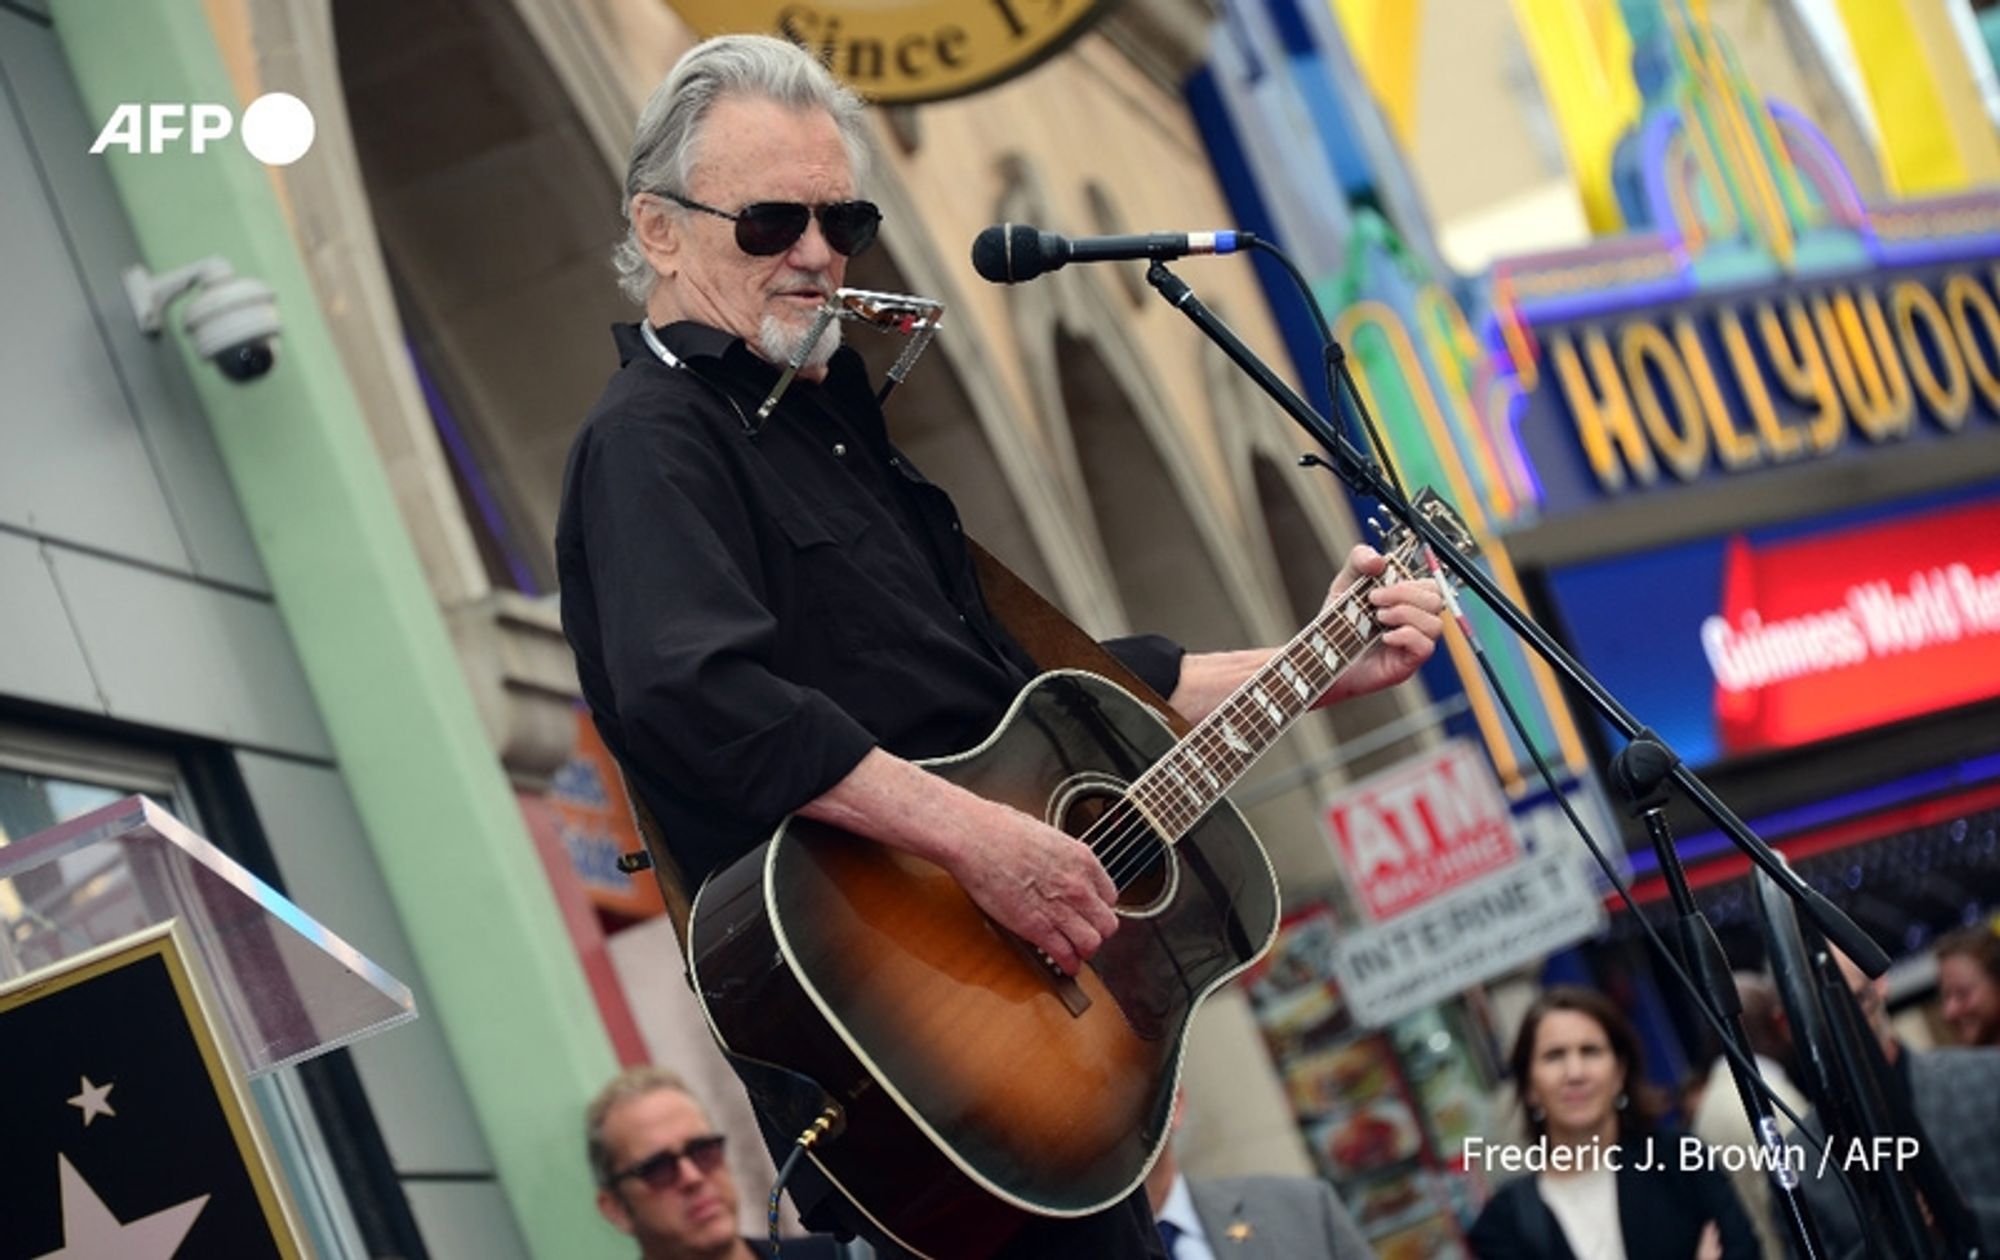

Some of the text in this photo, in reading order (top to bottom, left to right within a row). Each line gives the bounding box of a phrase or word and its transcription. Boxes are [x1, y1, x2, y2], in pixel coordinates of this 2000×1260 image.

[1550, 262, 2000, 490] HOLLYWOO
[1346, 756, 1492, 884] ATM
[1348, 860, 1568, 980] INTERNET
